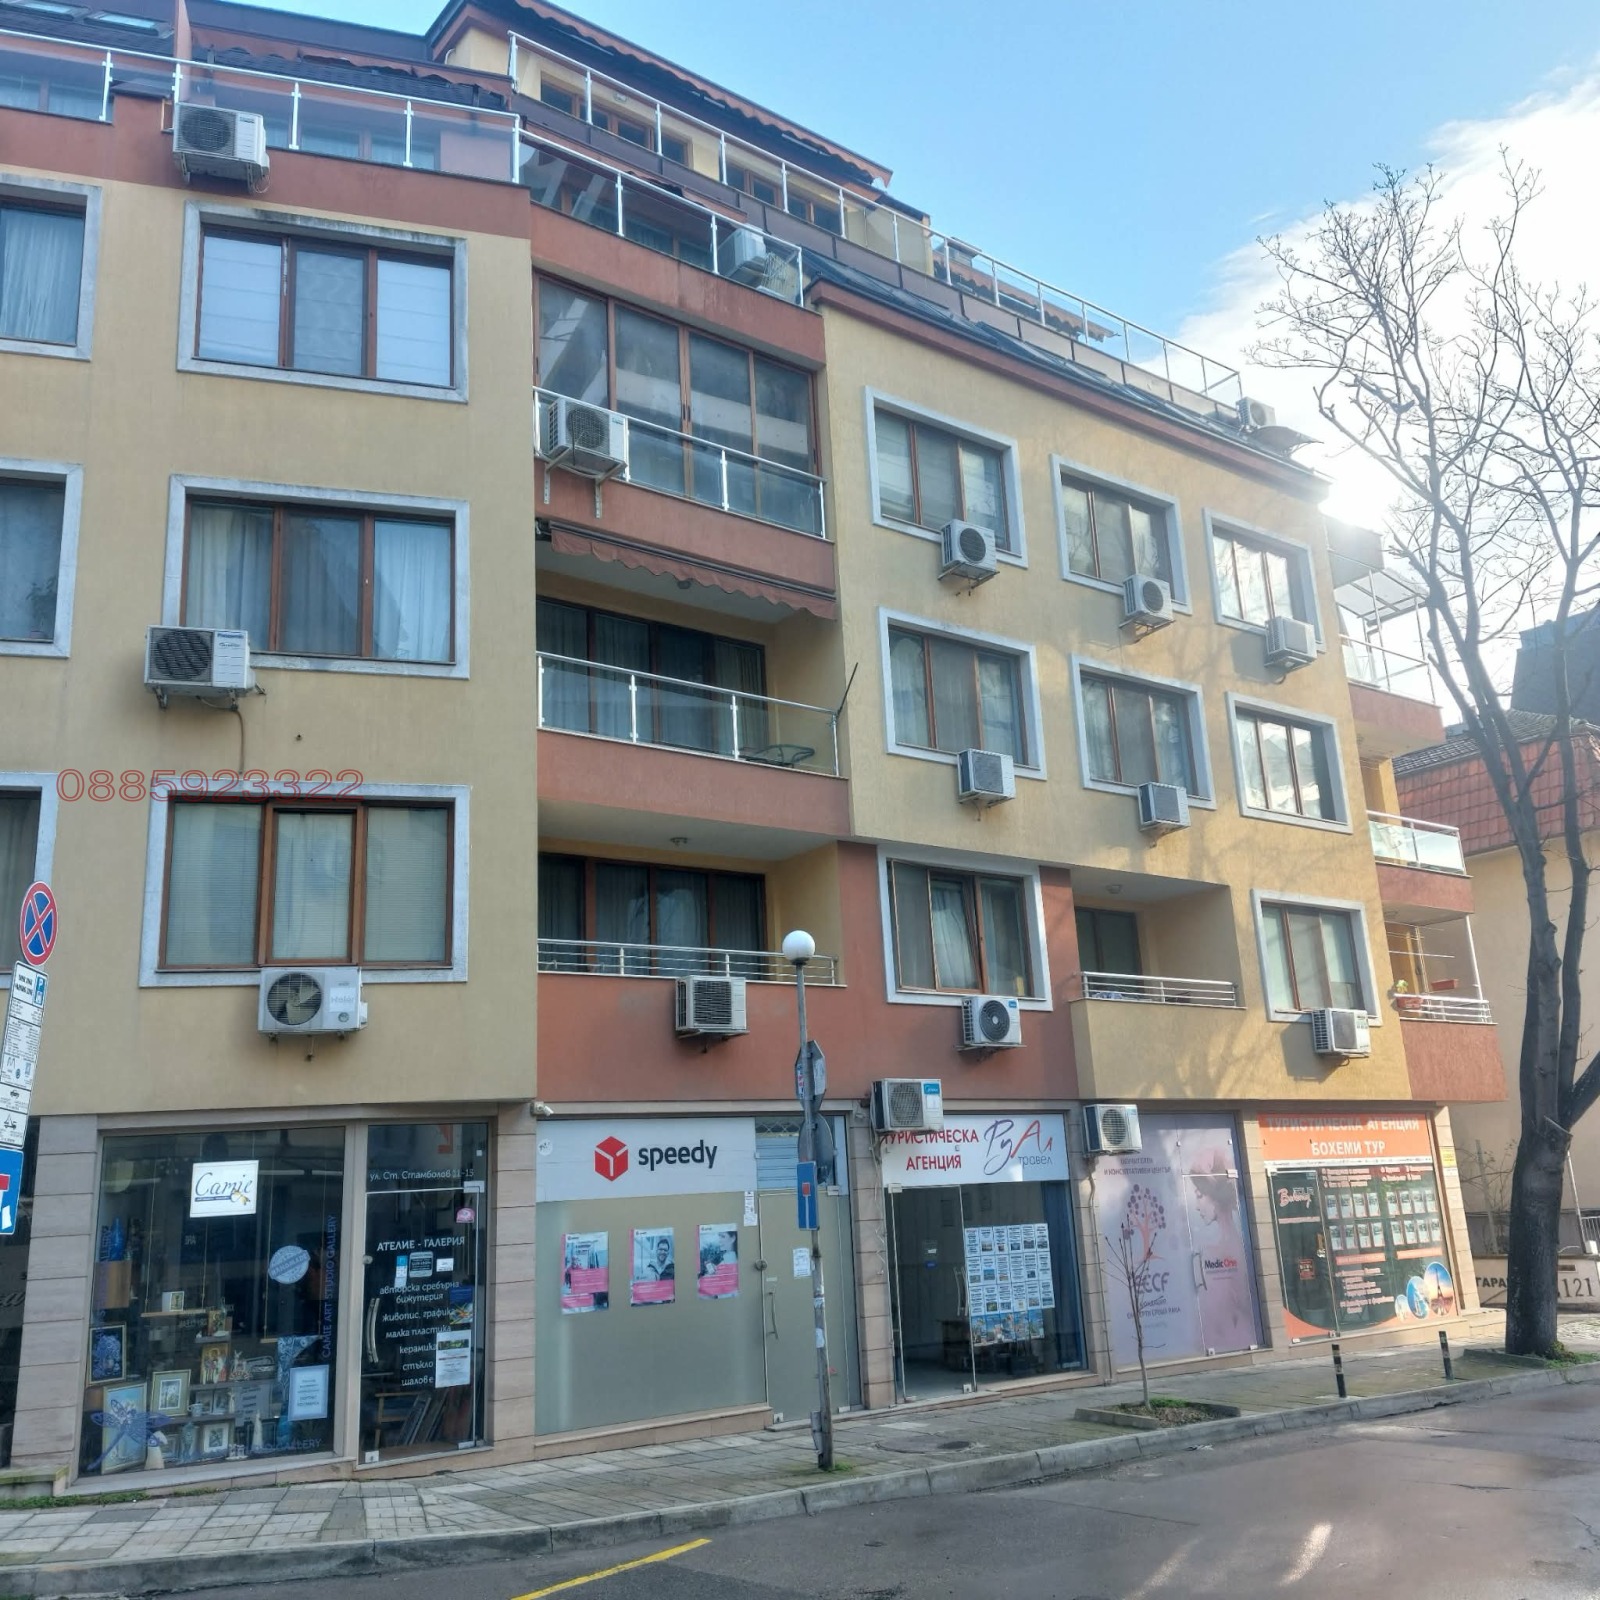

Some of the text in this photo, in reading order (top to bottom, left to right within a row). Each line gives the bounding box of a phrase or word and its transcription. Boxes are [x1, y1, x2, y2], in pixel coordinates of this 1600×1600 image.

[638, 1139, 718, 1171] speedy
[1311, 1140, 1385, 1156] БОХЕМИ ТУР
[906, 1154, 962, 1171] АГЕНЦИЯ
[1018, 1155, 1053, 1170] травел
[383, 1171, 399, 1180] Ст.
[195, 1172, 253, 1196] Camie
[376, 1240, 415, 1252] АТЕЛИЕ
[424, 1236, 465, 1248] ГАЛЕРИЯ
[322, 1214, 337, 1358] CAMIE ART STUDIO GALLERY
[380, 1284, 420, 1295] авторска
[1475, 1276, 1507, 1288] ГАРА
[396, 1293, 444, 1304] бижутерия
[385, 1324, 452, 1339] малка пластика
[402, 1361, 434, 1371] стъкло
[401, 1375, 434, 1386] шалове
